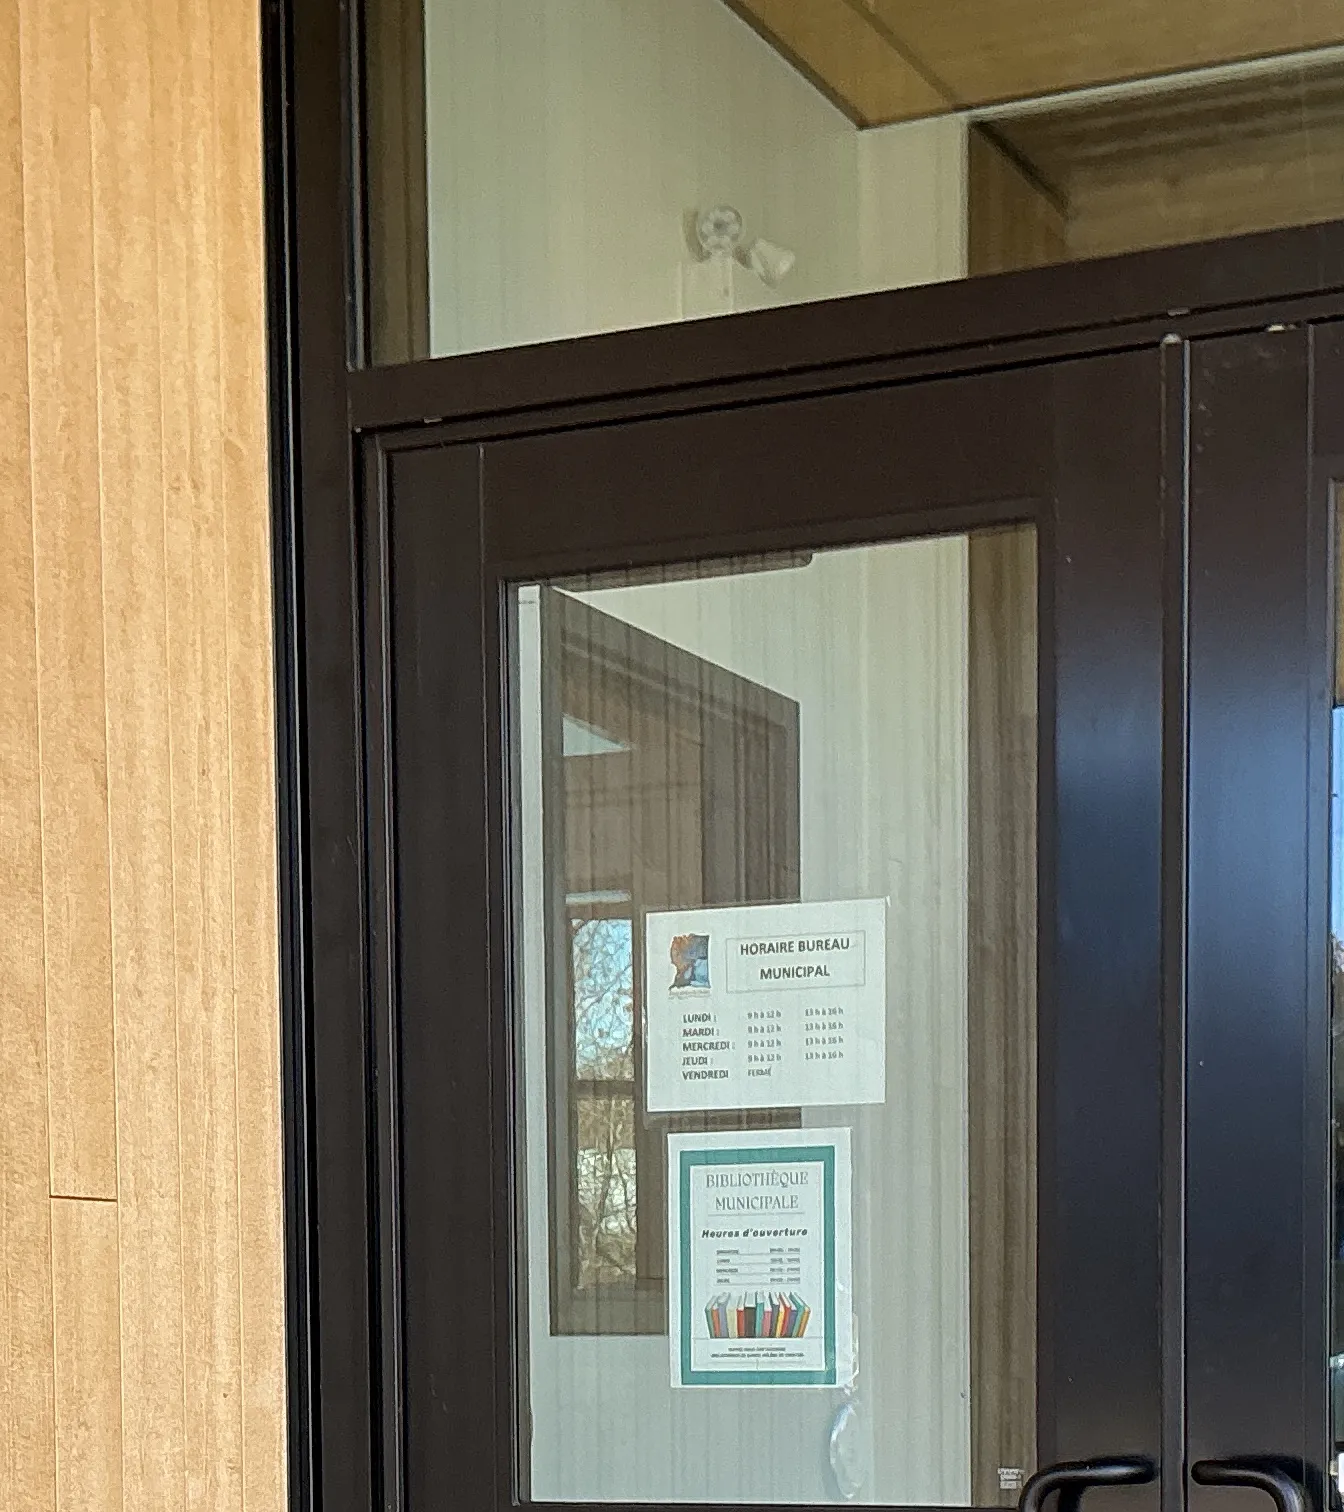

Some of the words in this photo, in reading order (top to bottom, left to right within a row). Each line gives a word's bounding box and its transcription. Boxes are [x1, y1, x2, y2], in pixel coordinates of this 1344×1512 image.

[740, 940, 795, 956] HORAIRE
[798, 937, 850, 952] BUREAU
[759, 964, 830, 980] MUNICIPAL
[683, 1013, 711, 1023] LUNDI
[682, 1027, 714, 1037] MARDI
[682, 1041, 730, 1051] MERCREDI
[682, 1056, 708, 1066] JEUDI
[682, 1069, 729, 1080] VENDREDI
[706, 1169, 809, 1188] BIBLIOTHÈQUE
[715, 1194, 799, 1210] MUNICIPALE
[701, 1229, 740, 1239] Heures
[743, 1228, 808, 1238] d'ouverture
